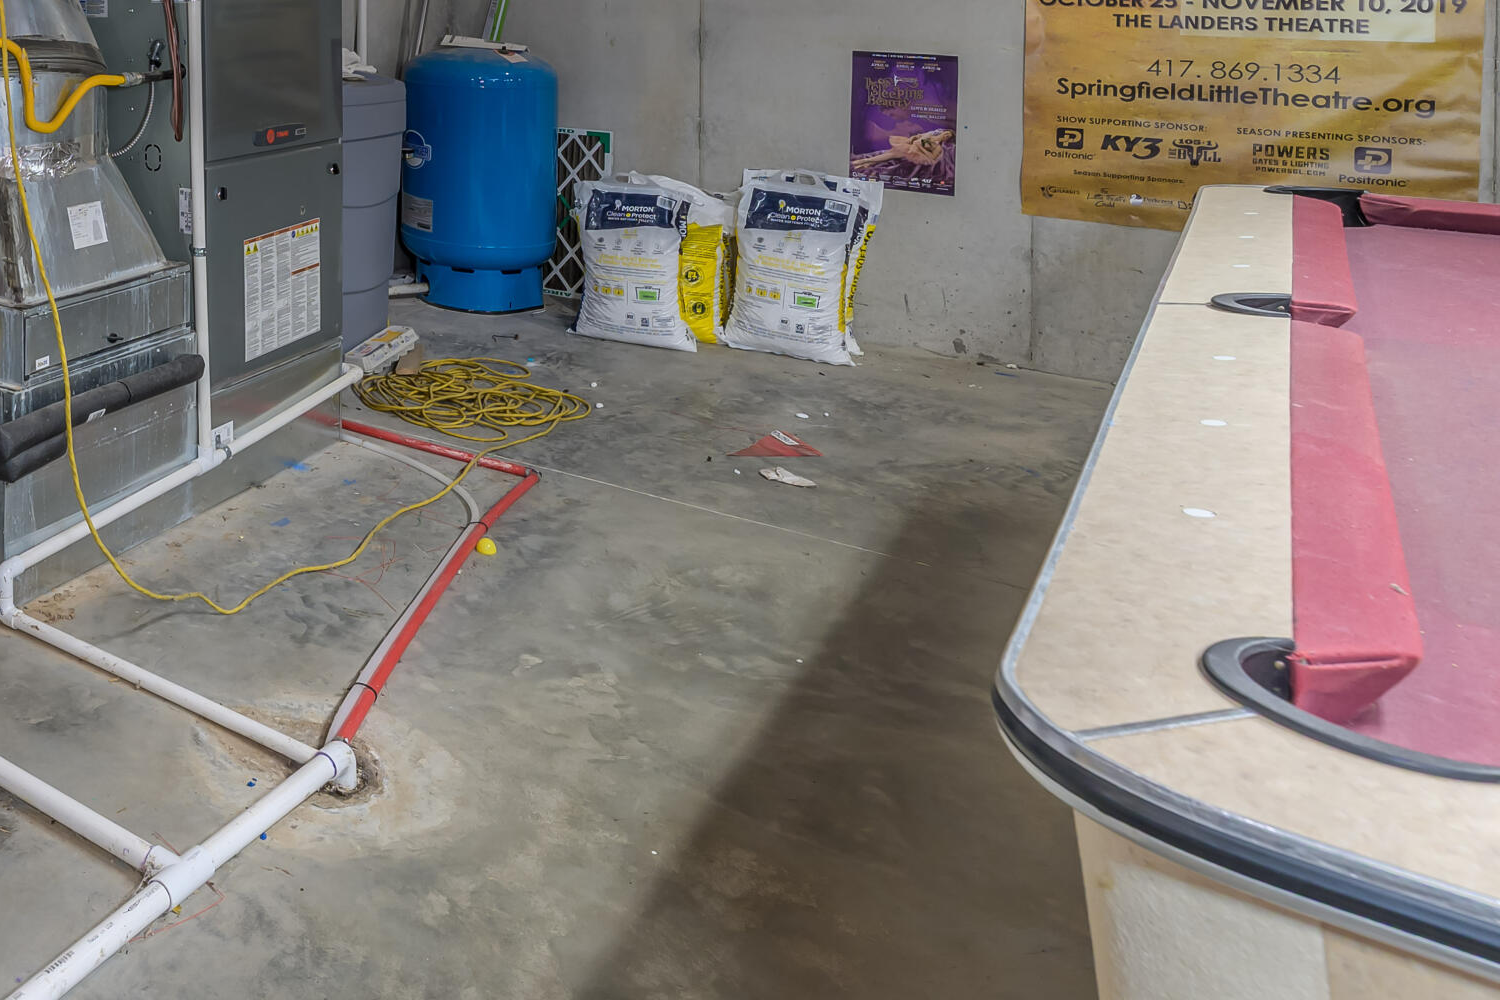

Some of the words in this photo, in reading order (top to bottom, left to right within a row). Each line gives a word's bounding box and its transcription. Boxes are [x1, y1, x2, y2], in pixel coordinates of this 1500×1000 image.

[1112, 13, 1152, 30] THE
[1158, 13, 1258, 33] LANDERS
[1264, 16, 1370, 35] THEATRE
[1056, 77, 1436, 119] SpringfieldLittleTheatre.org
[1056, 115, 1086, 124] SHOW
[1090, 117, 1151, 128] SUPPORTING
[1154, 121, 1208, 132] SPONSOR:
[1236, 127, 1281, 137] SEASON
[1285, 130, 1353, 141] PRESENTING
[1358, 134, 1426, 146] SPONSORS:
[1100, 134, 1163, 160] KY3
[1252, 143, 1330, 161] POWERS
[1044, 149, 1094, 161] Positronic
[1252, 158, 1279, 166] GATES
[1290, 160, 1330, 169] LIGHTING
[1073, 169, 1100, 177] Season
[1103, 171, 1145, 182] Supporting
[1339, 174, 1407, 188] Positronic
[622, 205, 654, 213] MORTON
[786, 206, 822, 216] MORTON
[631, 213, 656, 221] Protect
[770, 212, 791, 220] Clean
[796, 215, 823, 225] Protect
